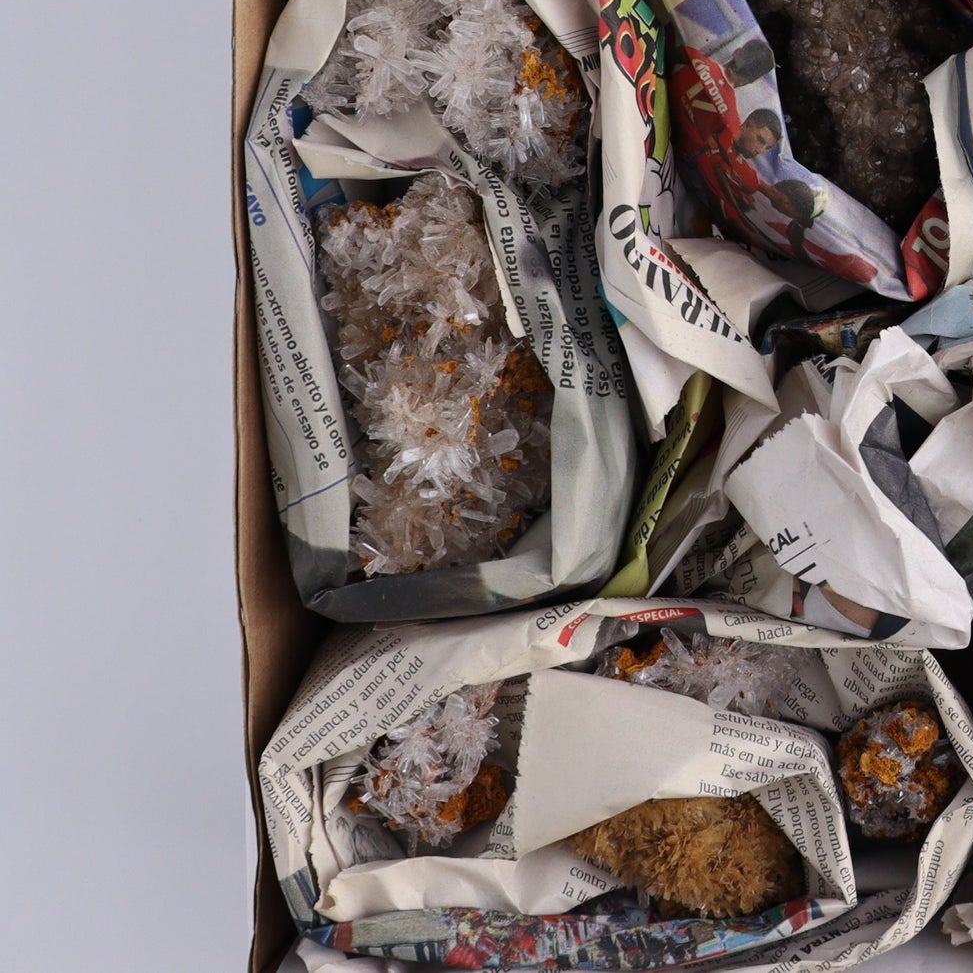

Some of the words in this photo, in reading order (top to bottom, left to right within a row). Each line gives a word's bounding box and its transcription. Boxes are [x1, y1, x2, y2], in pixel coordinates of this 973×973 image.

[691, 56, 730, 115] Corona
[550, 223, 561, 240] la
[499, 225, 521, 288] intenta
[257, 268, 269, 288] un
[265, 289, 297, 350] extremo
[575, 307, 587, 327] de
[560, 323, 576, 390] presión
[256, 302, 268, 326] los
[265, 329, 287, 373] tubos
[282, 376, 295, 394] de
[291, 398, 319, 450] ensayo
[314, 452, 330, 471] se
[292, 351, 322, 403] abierto
[583, 363, 594, 396] aire
[313, 403, 328, 414] y
[322, 414, 337, 429] el
[329, 429, 347, 459] otro
[630, 608, 684, 623] ESPECIAL
[757, 624, 793, 642] hacia
[843, 677, 869, 705] ubica
[851, 661, 876, 693] tancia
[271, 736, 290, 753] un
[288, 679, 354, 738] recordatorio
[353, 638, 402, 681] duradero
[292, 709, 350, 762] resiliencia
[349, 701, 360, 712] y
[359, 670, 388, 701] amor
[386, 647, 409, 674] per-
[325, 741, 340, 757] El
[375, 688, 396, 710] dijo
[394, 656, 424, 687] Todd
[944, 705, 960, 723] se
[713, 724, 770, 747] personas
[773, 739, 784, 752] y
[709, 741, 736, 758] más
[738, 750, 754, 764] en
[757, 755, 774, 768] un
[777, 762, 806, 771] acto
[720, 763, 744, 780] Ese
[783, 779, 797, 803] más
[788, 806, 808, 853] porque
[562, 882, 574, 897] la
[570, 866, 607, 891] contra
[839, 867, 853, 887] en
